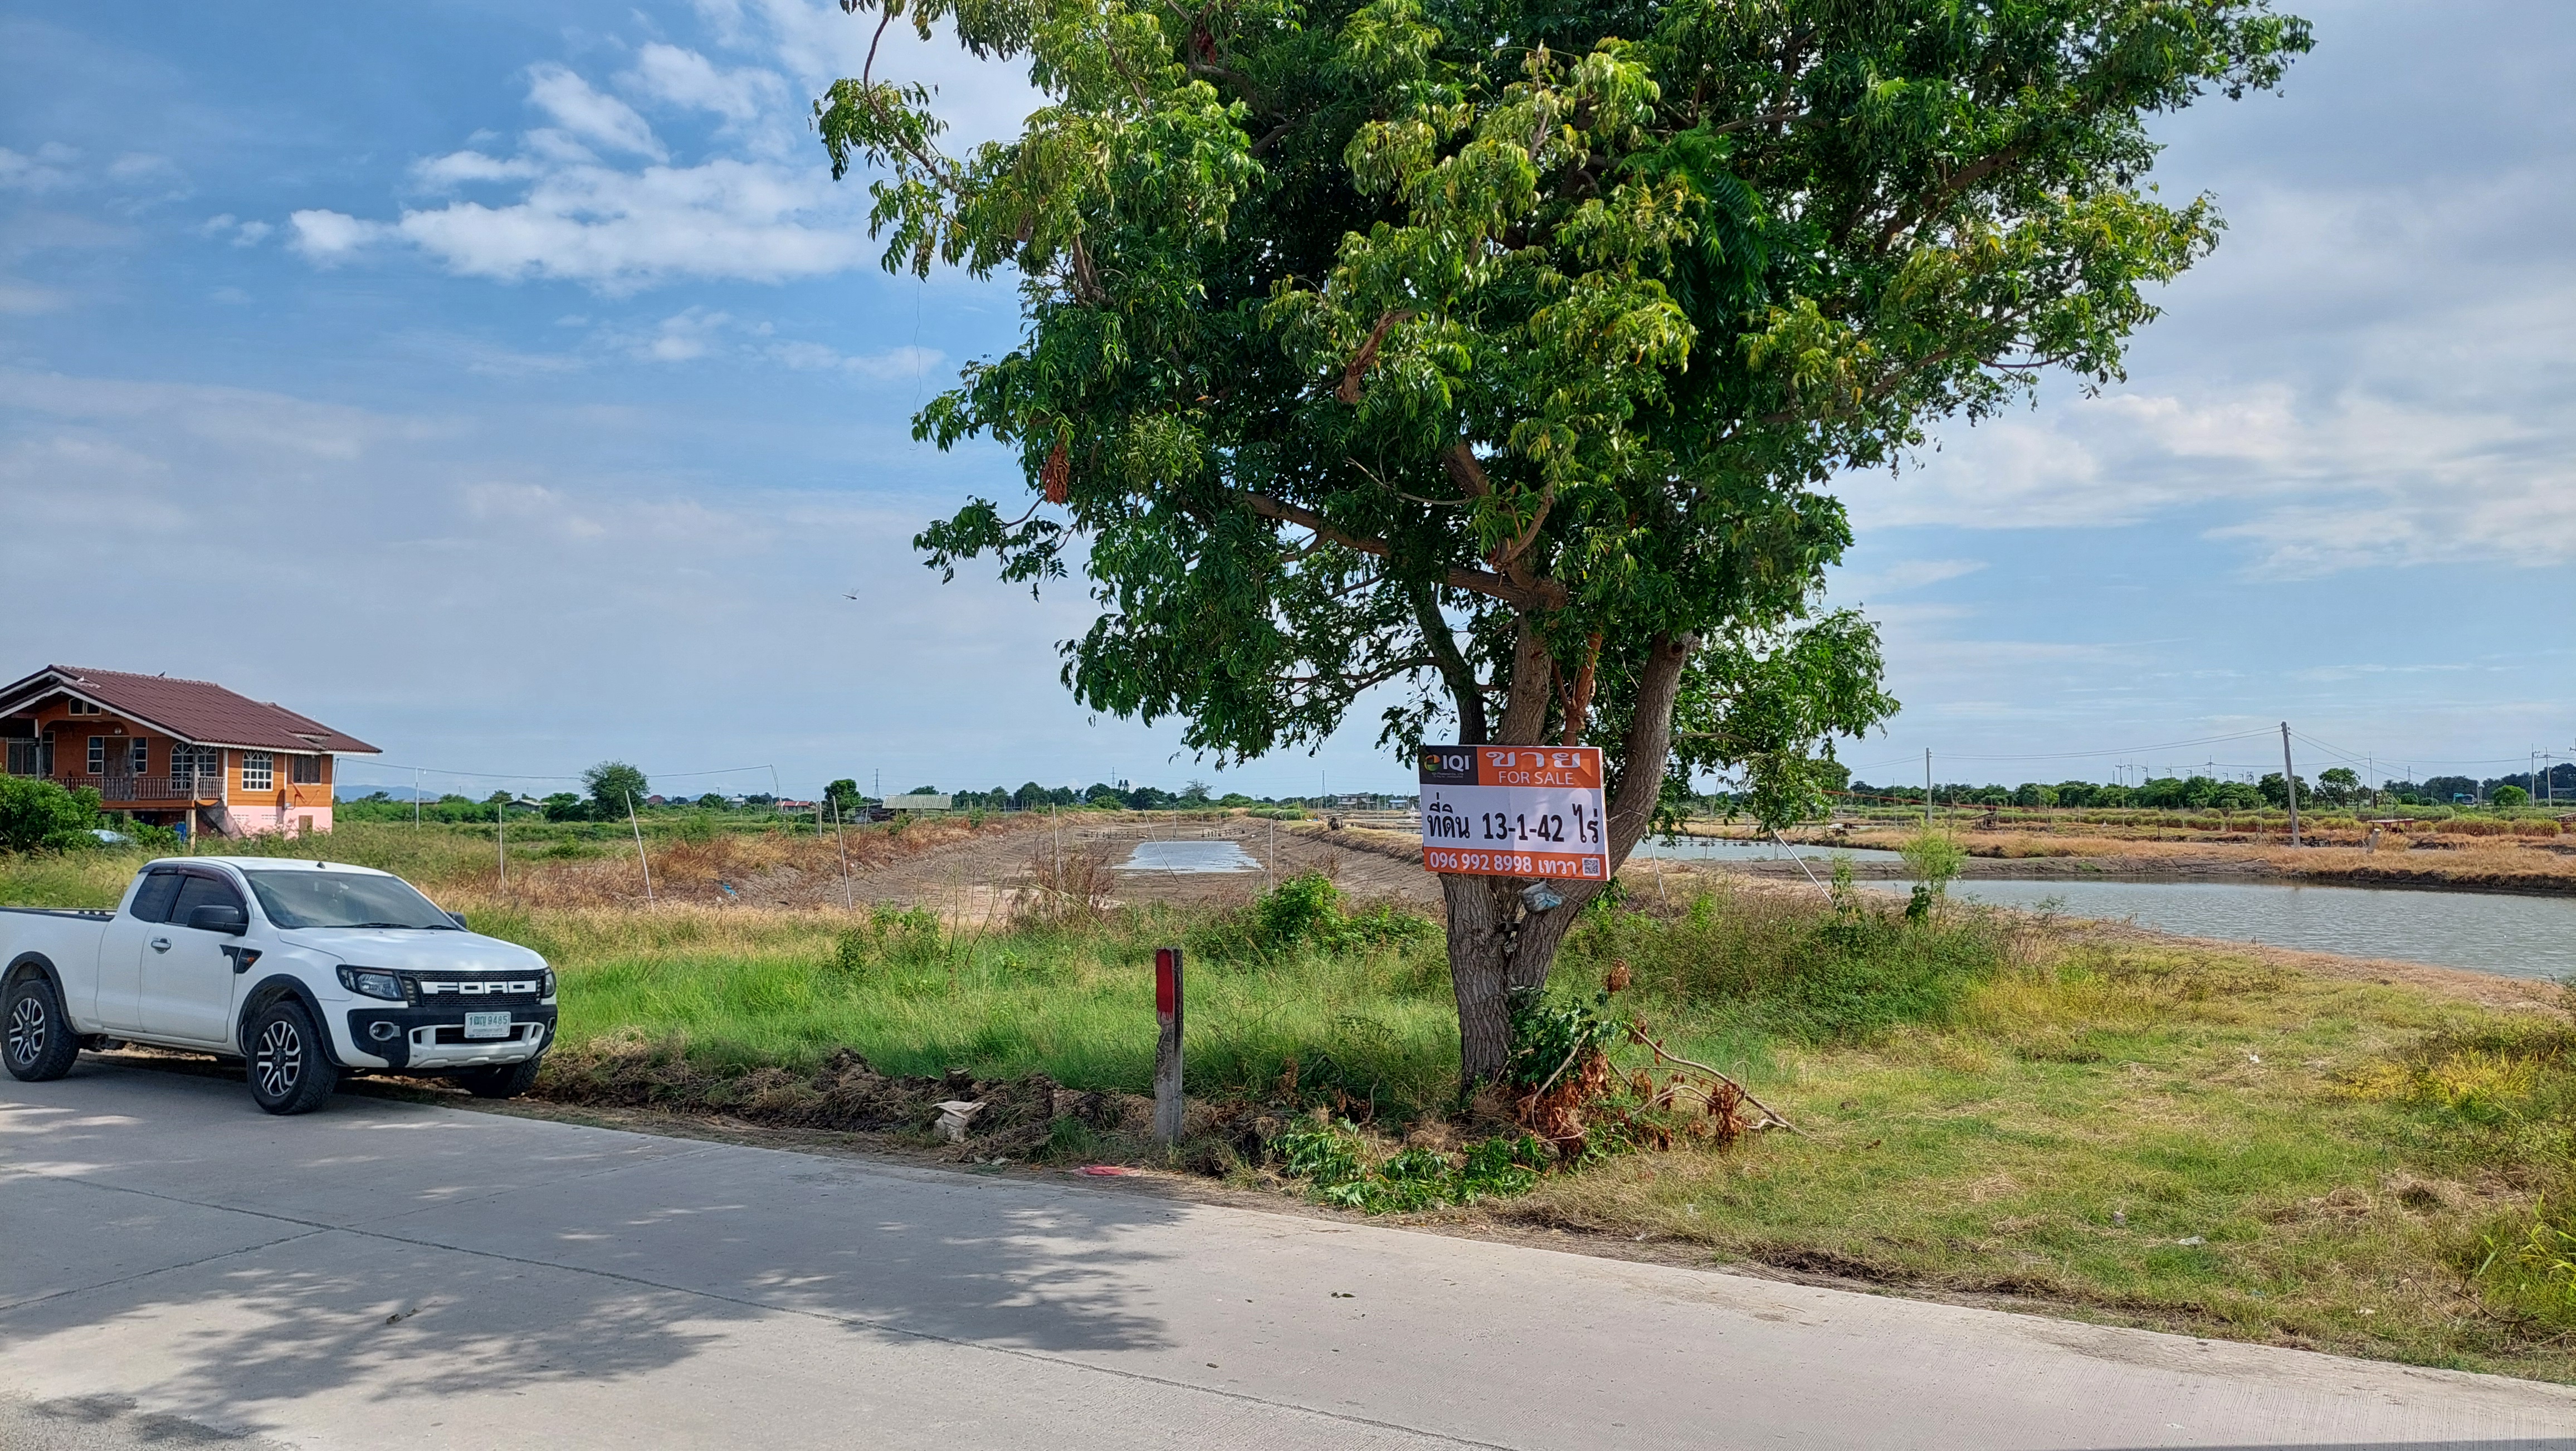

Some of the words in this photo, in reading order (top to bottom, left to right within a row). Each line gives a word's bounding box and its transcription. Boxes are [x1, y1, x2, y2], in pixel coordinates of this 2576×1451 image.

[1442, 754, 1470, 772] IQI
[1485, 751, 1580, 768] ขาย
[1498, 771, 1530, 784] FOR
[1534, 771, 1575, 785] SALE
[1427, 792, 1470, 839] ที่ดิน
[1482, 812, 1564, 843] 13-1-42
[1572, 803, 1599, 844] ไร่
[1430, 851, 1458, 869] 096
[1461, 853, 1490, 870] 992
[1494, 854, 1533, 873] 8998
[1538, 859, 1577, 875] เทวา
[420, 980, 536, 994] FORD
